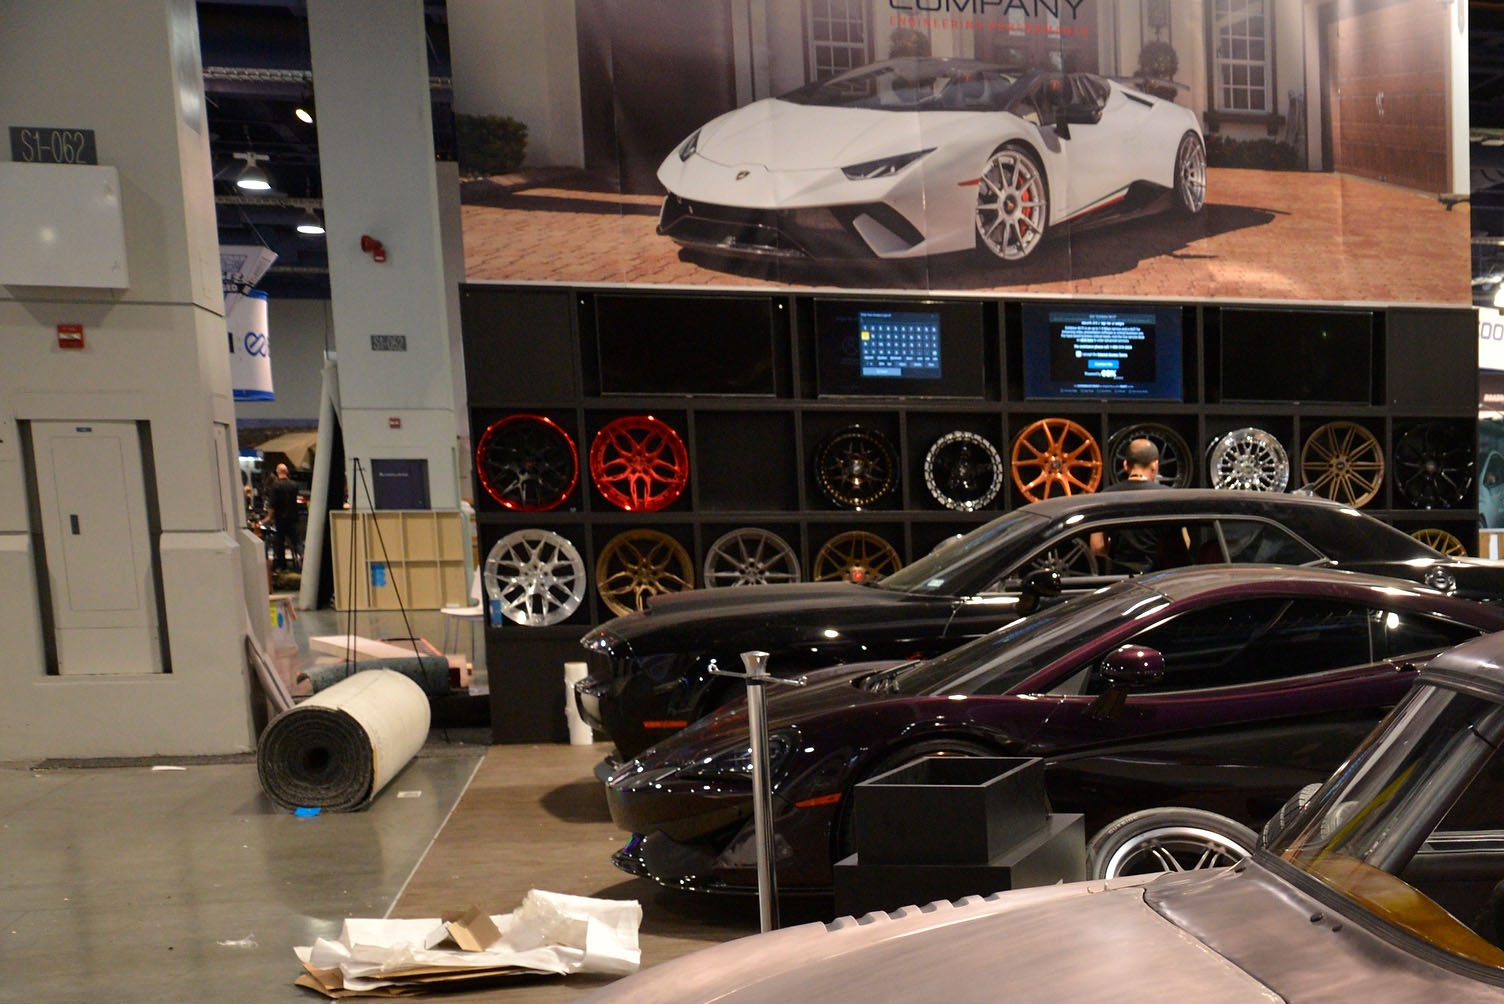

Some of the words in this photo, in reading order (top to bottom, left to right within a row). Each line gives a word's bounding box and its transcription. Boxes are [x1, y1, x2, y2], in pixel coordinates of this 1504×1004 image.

[889, 16, 984, 32] ENGINEERING
[989, 22, 1089, 38] PERFORMANCE
[21, 129, 87, 164] S1-062
